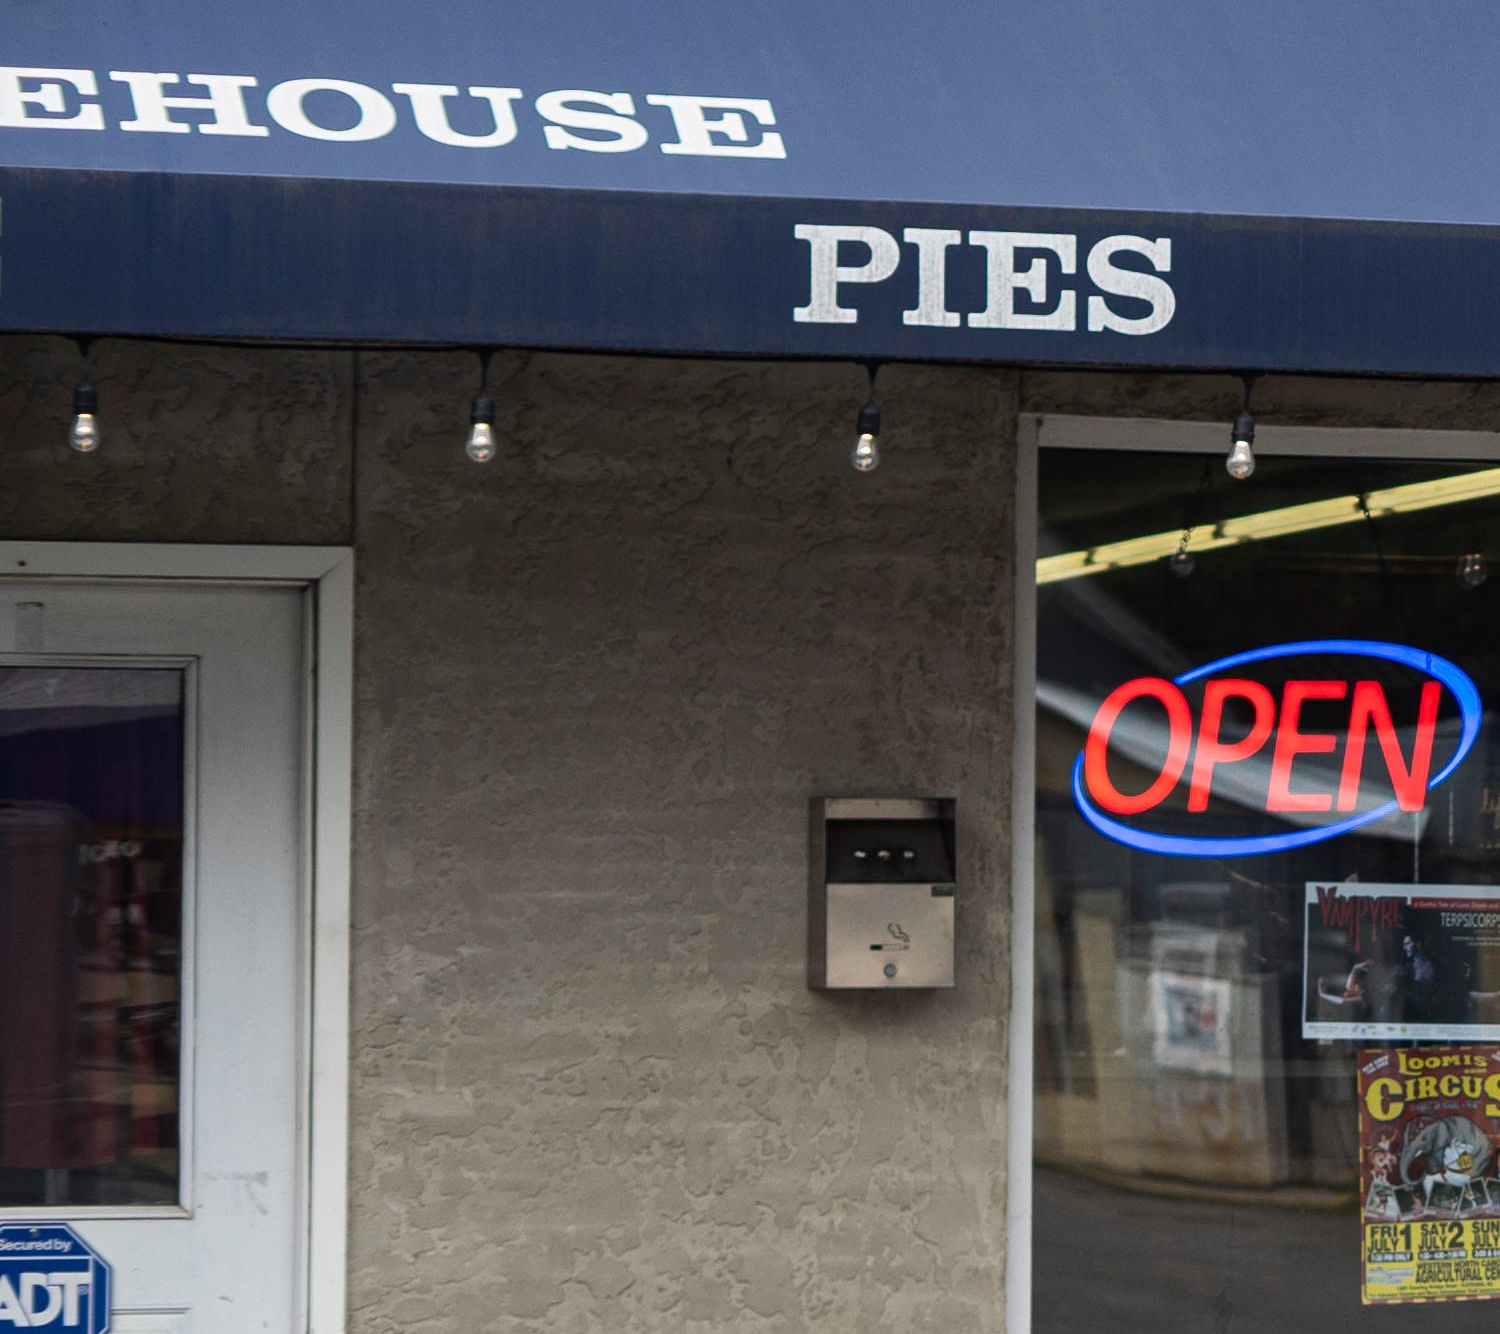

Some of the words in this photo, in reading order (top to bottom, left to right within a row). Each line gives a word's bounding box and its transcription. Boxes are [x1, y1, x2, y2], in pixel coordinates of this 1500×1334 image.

[0, 67, 787, 159] EHOUSE
[793, 223, 1176, 337] PIES
[1084, 676, 1442, 815] OPEN
[1316, 886, 1408, 954] VAMPYRE
[1397, 1050, 1488, 1076] LOOMIS
[1371, 1225, 1398, 1238] FRI
[1399, 1224, 1412, 1250] 1
[1421, 1223, 1447, 1236] SAT
[1448, 1221, 1465, 1248] 2
[1472, 1221, 1500, 1234] SUN
[57, 1238, 72, 1253] by
[1368, 1237, 1399, 1252] JULY
[1418, 1236, 1447, 1250] JULY
[1472, 1234, 1500, 1248] JULY
[1416, 1268, 1482, 1283] AGRICULTURAL
[0, 1272, 91, 1327] ADT
